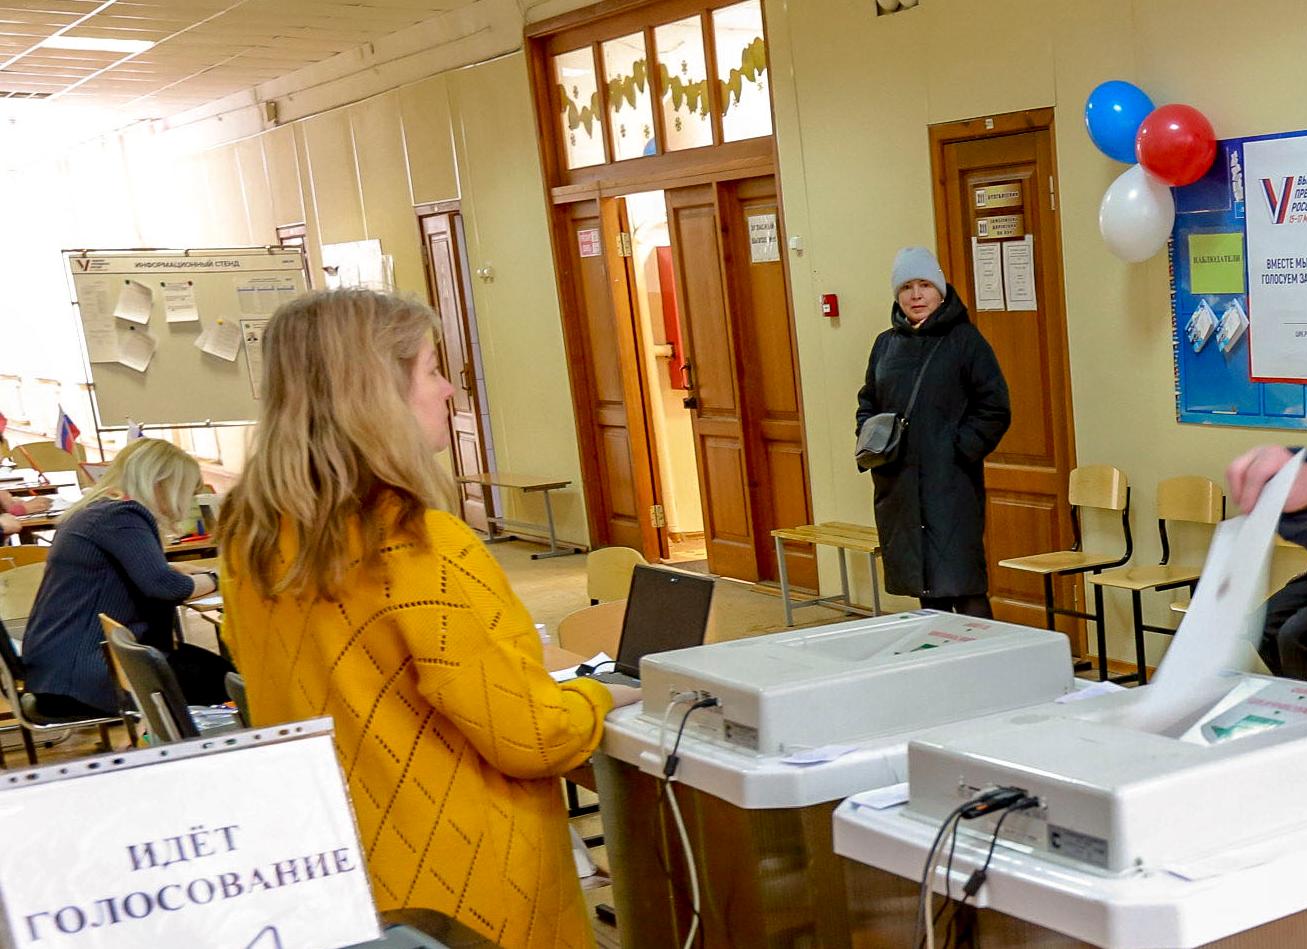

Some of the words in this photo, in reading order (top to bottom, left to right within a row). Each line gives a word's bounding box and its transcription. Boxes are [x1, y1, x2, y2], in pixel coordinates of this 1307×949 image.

[134, 260, 214, 269] ИНФОРМАЦИОННЫЙ
[214, 260, 240, 268] СТЕНД
[1193, 254, 1240, 264] НАБЛЮДАТЕЛИ
[1266, 258, 1294, 269] ВМЕСТЕ
[1295, 258, 1307, 269] МЫ
[1261, 273, 1298, 284] ГОЛОСУЕМ
[127, 824, 242, 871] ИДЁТ
[24, 847, 357, 942] ГОЛОСОВАНИЕ
